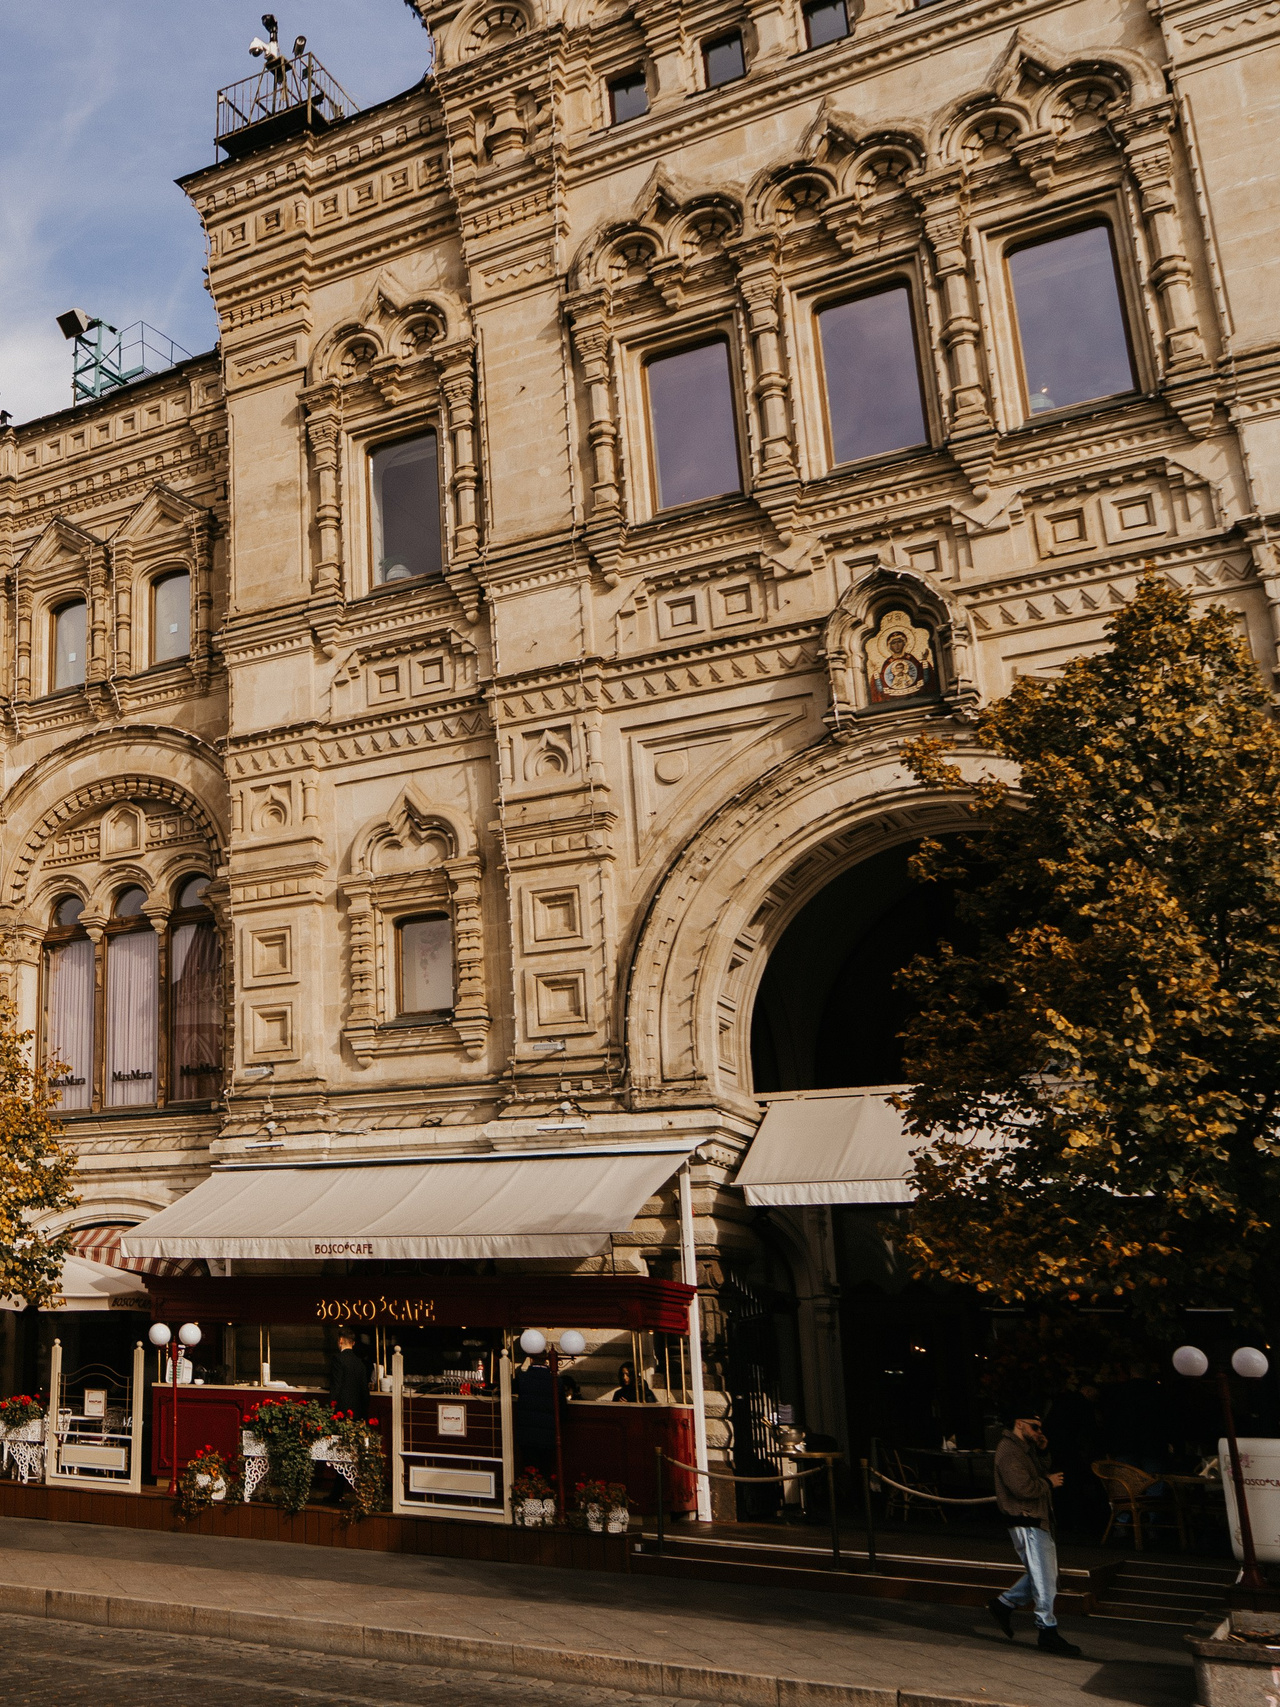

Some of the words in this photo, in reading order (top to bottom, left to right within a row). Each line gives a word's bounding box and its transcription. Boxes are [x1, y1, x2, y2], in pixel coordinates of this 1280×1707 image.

[112, 1069, 153, 1082] MaxMara
[314, 1244, 345, 1254] BOSCO
[349, 1243, 374, 1254] CAFE
[316, 1299, 376, 1321] BOSCO
[388, 1299, 435, 1321] CAFE
[1244, 1478, 1266, 1486] OSCO
